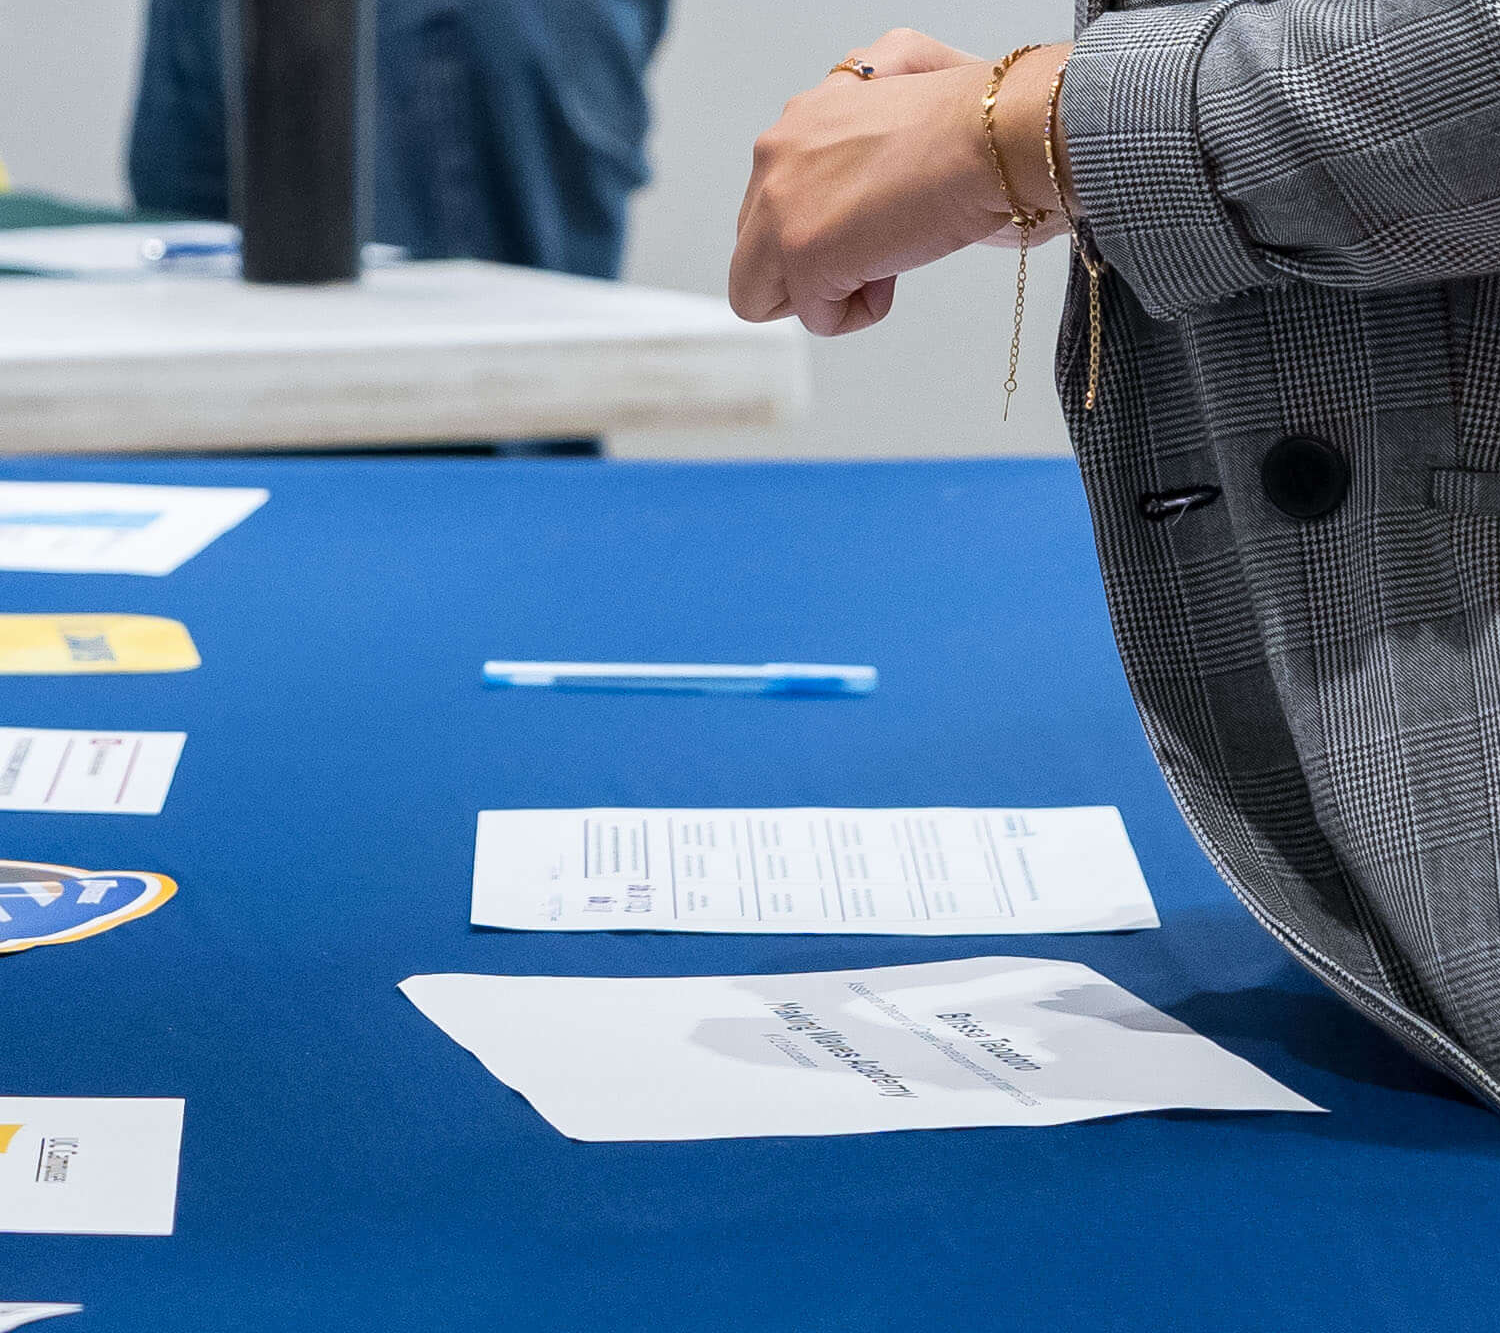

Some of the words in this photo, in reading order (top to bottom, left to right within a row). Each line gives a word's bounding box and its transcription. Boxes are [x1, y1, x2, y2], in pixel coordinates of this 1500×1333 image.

[764, 1002, 822, 1031] Making
[805, 1031, 861, 1058] Waves
[841, 1059, 919, 1098] Academy
[936, 1011, 991, 1037] Brissa
[974, 1037, 1042, 1071] Teodoro
